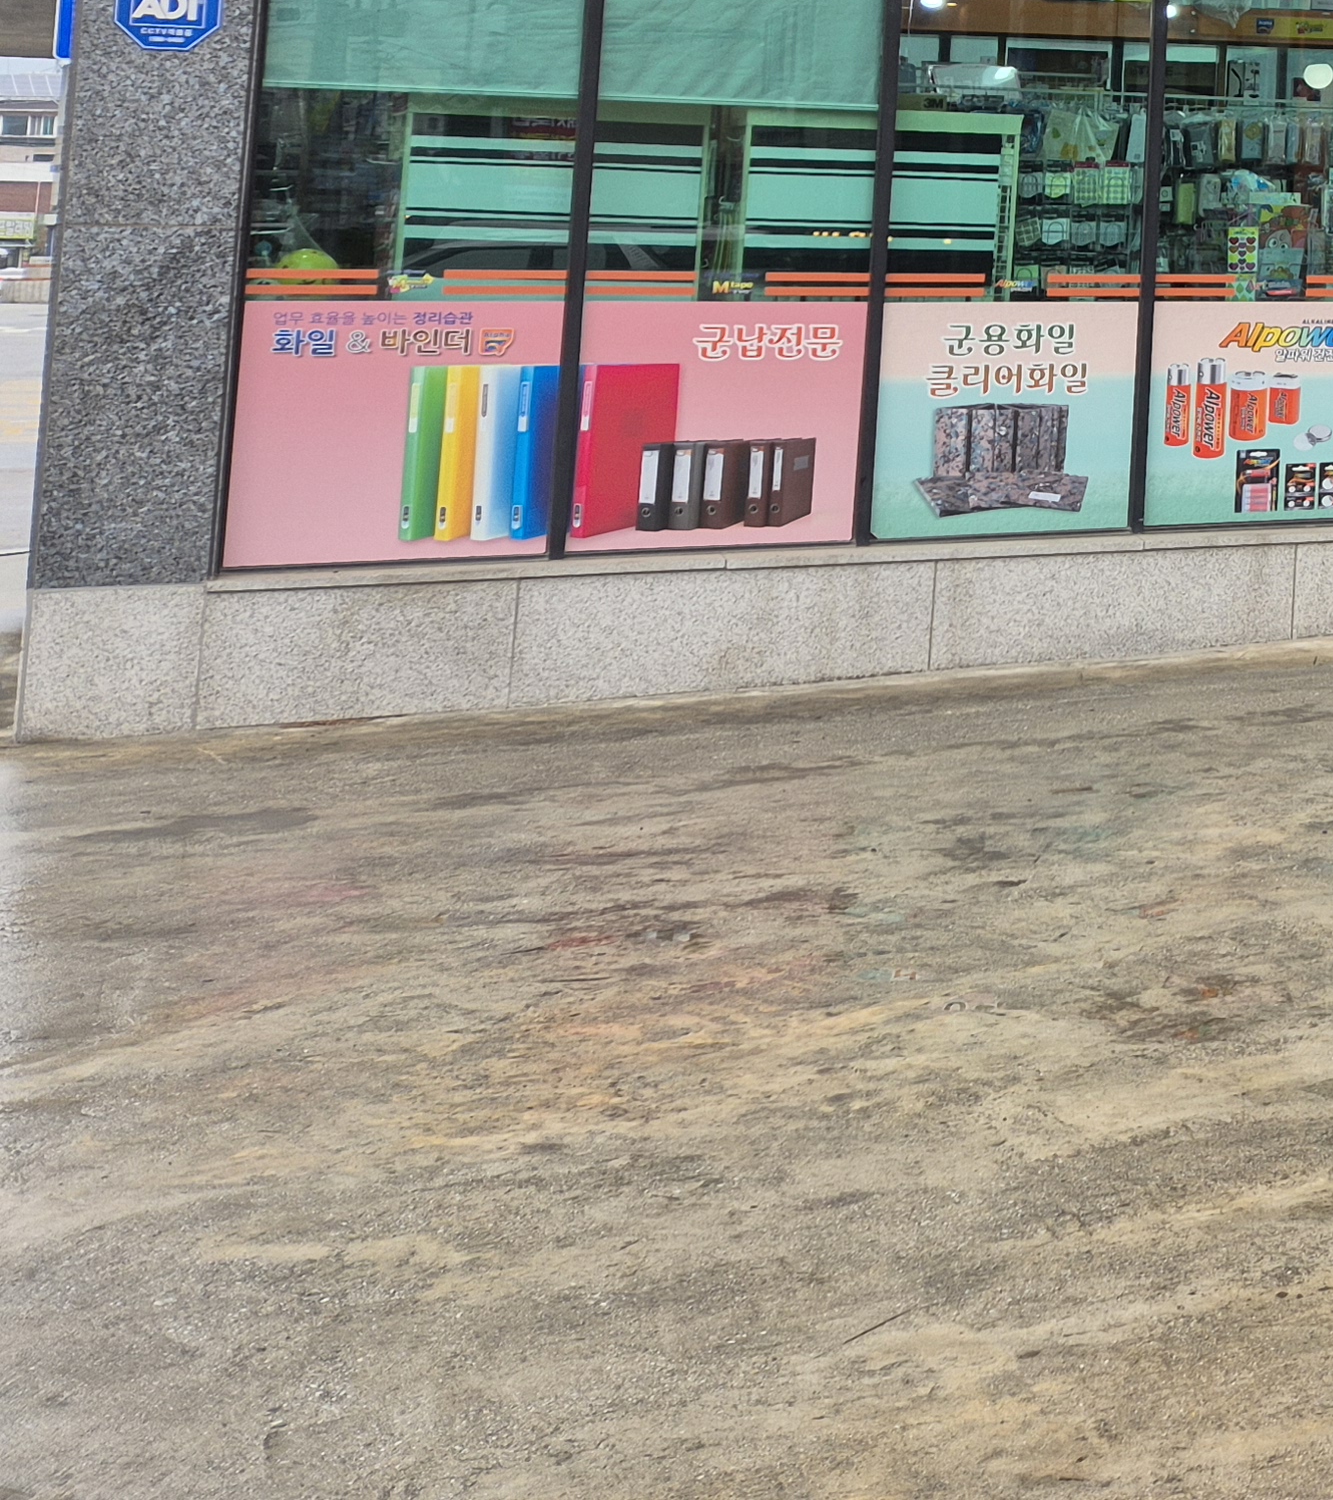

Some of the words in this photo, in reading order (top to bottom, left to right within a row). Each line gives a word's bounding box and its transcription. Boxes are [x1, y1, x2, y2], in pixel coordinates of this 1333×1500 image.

[273, 312, 304, 325] 업무
[309, 312, 356, 326] 효율을
[362, 312, 407, 326] 높이는
[413, 312, 474, 325] 정리습관
[271, 328, 337, 356] 화일
[346, 331, 370, 354] &
[380, 328, 471, 356] 바인더
[693, 322, 844, 362] 군납전문
[942, 322, 1076, 359] 군용화일
[1274, 349, 1312, 362] 알파워
[925, 362, 1089, 399] 클리어화일
[1172, 388, 1187, 437] Alpower
[1205, 388, 1220, 449] Alpower
[1247, 393, 1258, 434] Alpower
